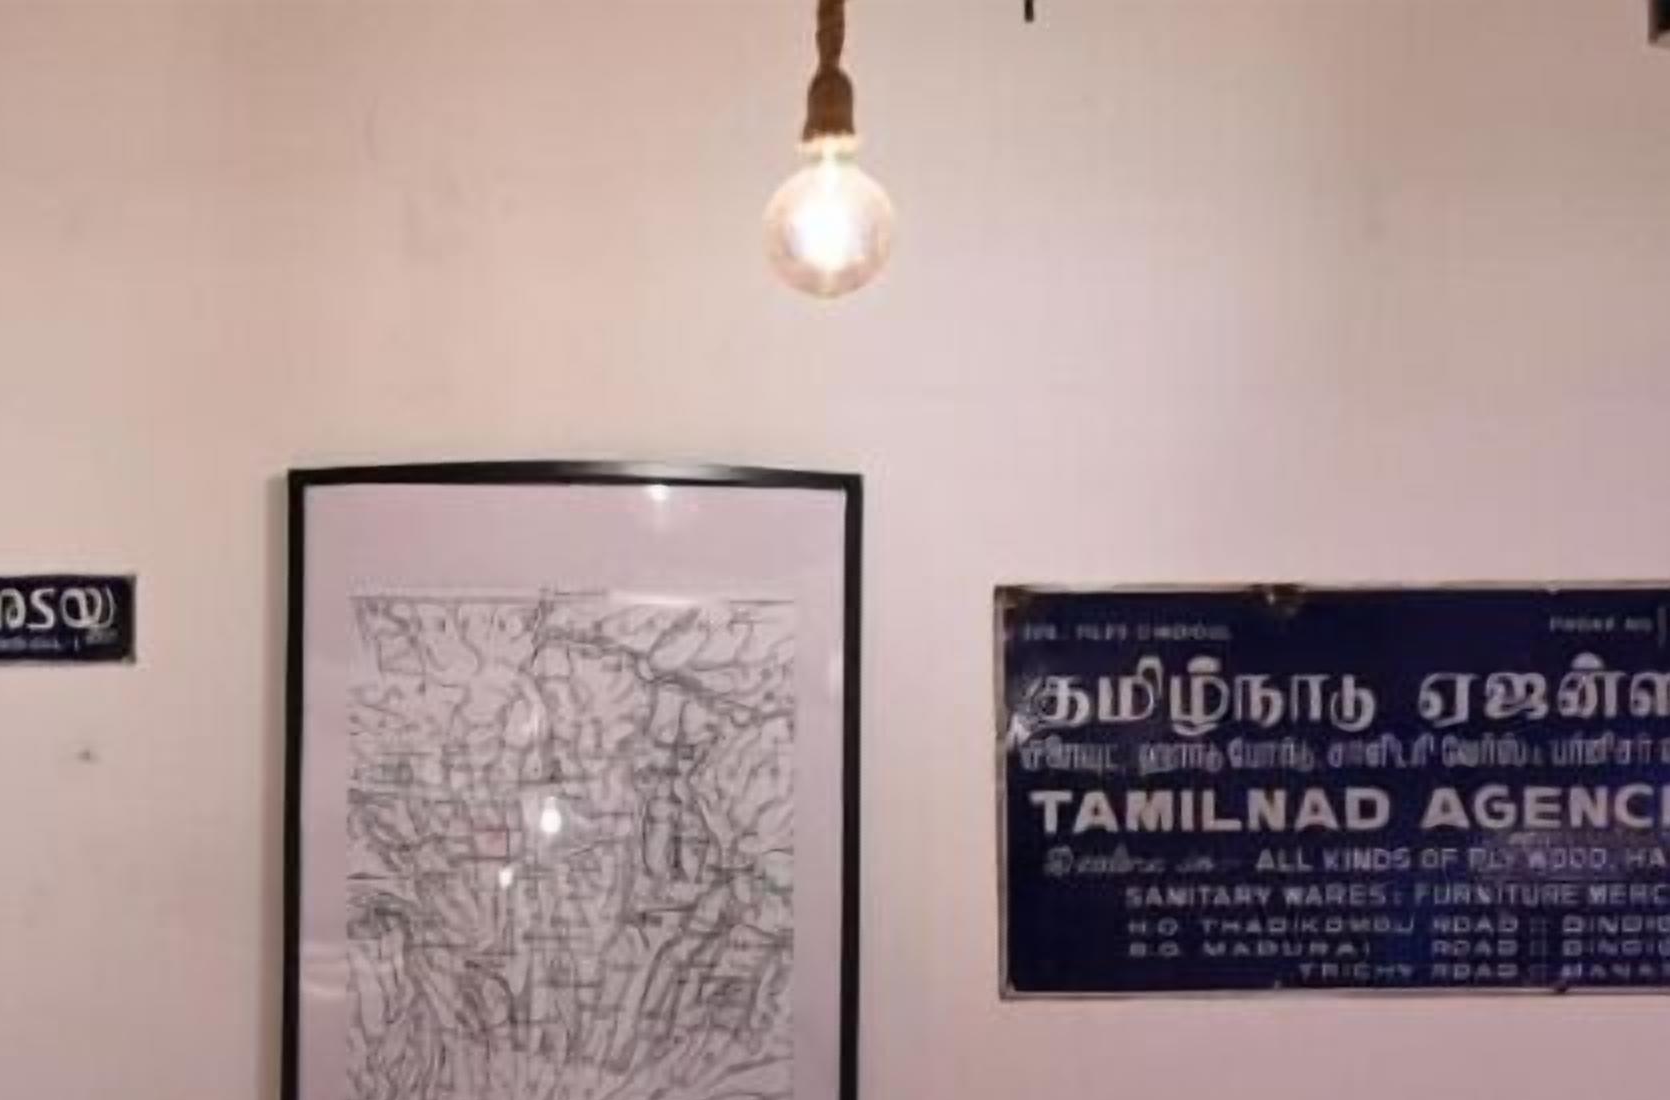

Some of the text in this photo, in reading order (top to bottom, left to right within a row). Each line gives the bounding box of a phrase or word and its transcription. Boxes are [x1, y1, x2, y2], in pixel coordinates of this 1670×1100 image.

[1026, 655, 1376, 736] தமிழ்நாடு
[1030, 788, 1391, 833] TAMILNAD
[1256, 848, 1314, 872] ALL
[1322, 848, 1411, 872] KINDS
[1420, 848, 1458, 869] OF
[1125, 884, 1272, 907] SANITARY
[1414, 882, 1580, 905] FURNITURE
